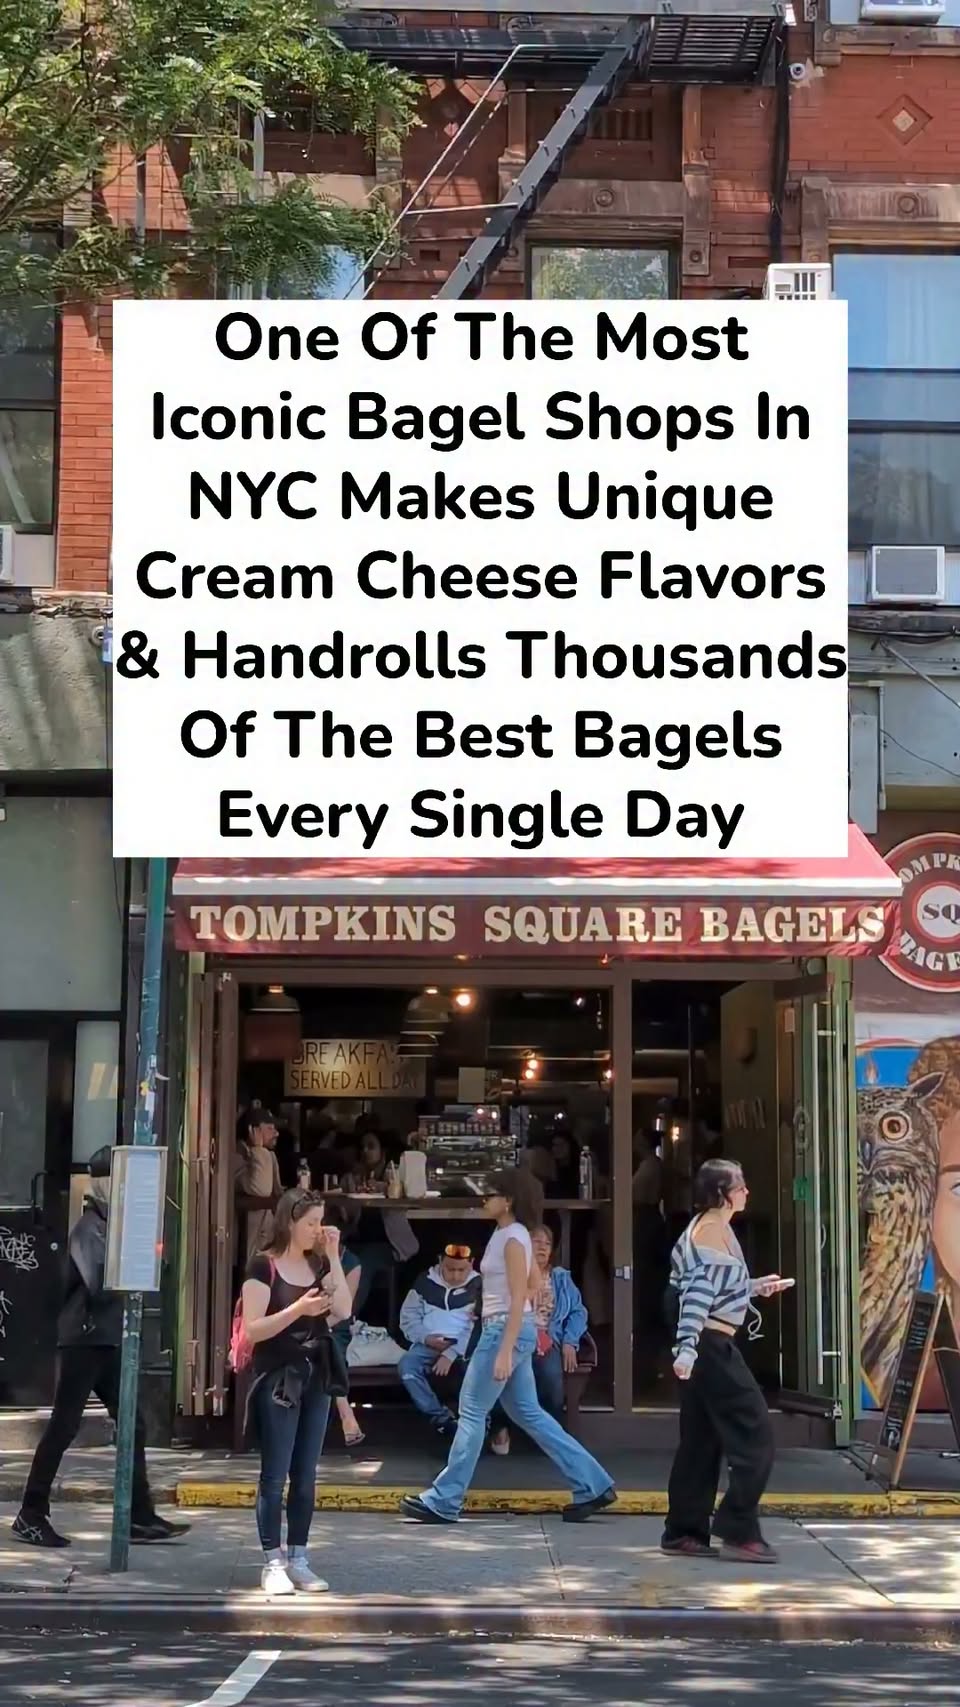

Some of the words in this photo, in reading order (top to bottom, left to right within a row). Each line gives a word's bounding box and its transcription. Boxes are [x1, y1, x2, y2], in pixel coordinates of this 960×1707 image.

[190, 905, 456, 942] TOMPKINS
[484, 905, 683, 945] SQUARE
[700, 906, 885, 943] BAGELS
[290, 1070, 351, 1090] SERVED
[355, 1070, 387, 1089] ALL
